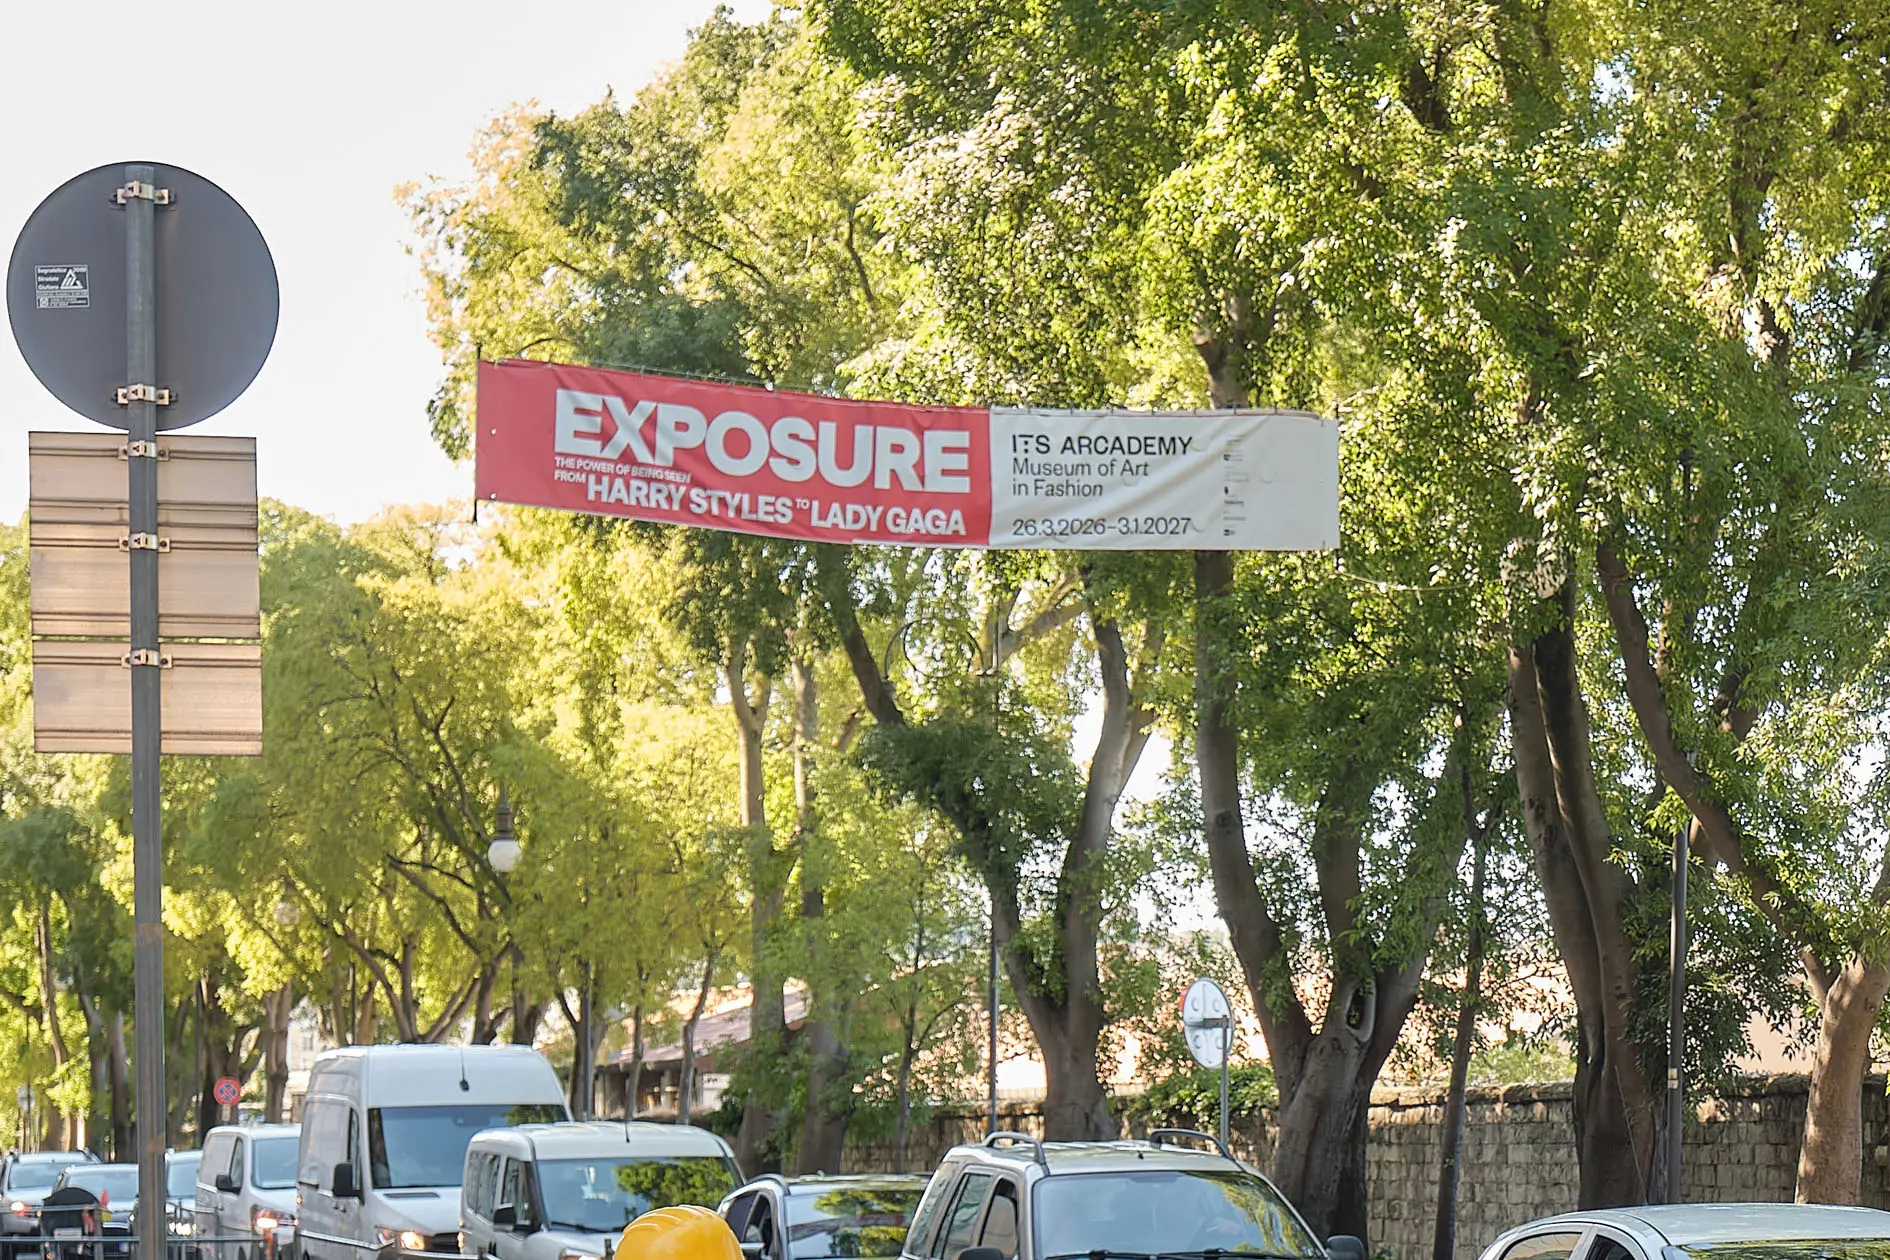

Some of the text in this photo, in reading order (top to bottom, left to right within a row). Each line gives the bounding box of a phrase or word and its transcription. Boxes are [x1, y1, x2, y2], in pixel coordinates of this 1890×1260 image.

[554, 388, 970, 494] EXPOSURE
[1012, 434, 1193, 456] ITS ARCADEMY
[554, 456, 691, 483] THE POWER OF BEING SEEN
[1012, 457, 1150, 477] Museum of Art
[1012, 479, 1103, 497] in Fashion
[554, 469, 967, 536] FROM HARRY STYLES TO LADY GAGA
